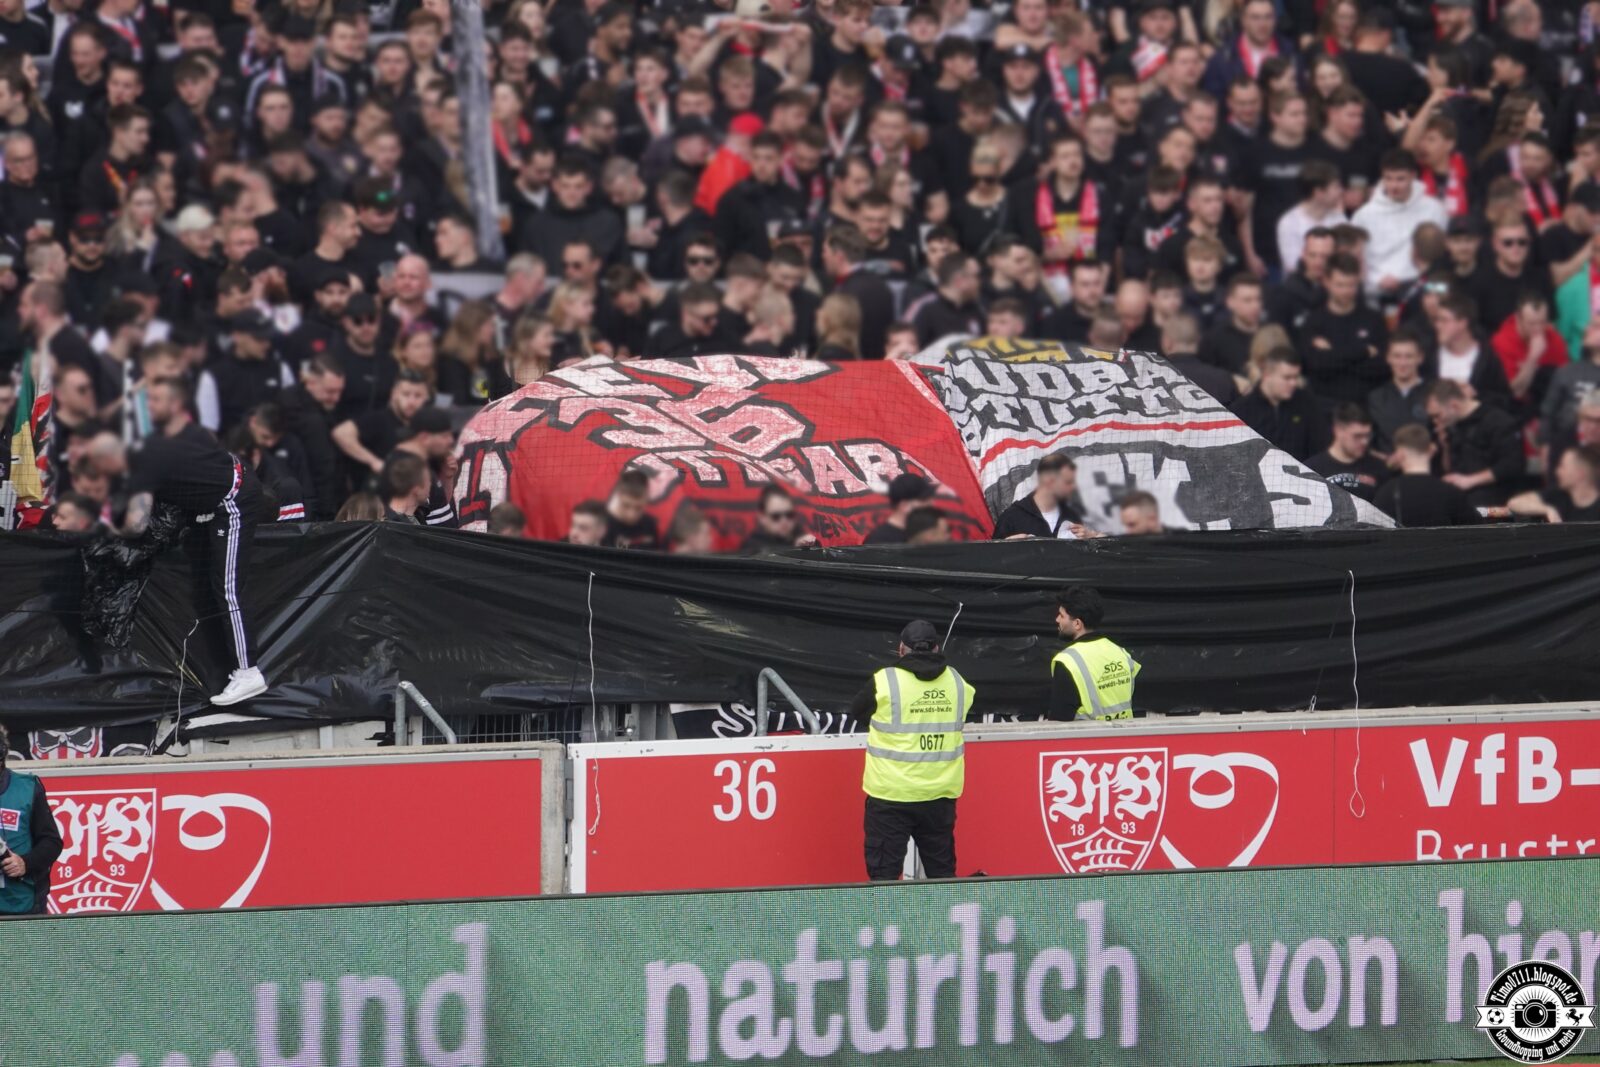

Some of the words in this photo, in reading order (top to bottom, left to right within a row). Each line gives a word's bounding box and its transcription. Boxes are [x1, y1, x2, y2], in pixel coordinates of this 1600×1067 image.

[558, 383, 807, 458] 36
[1104, 661, 1124, 674] SDS
[922, 689, 946, 700] SDS
[909, 705, 953, 714] www.sds-bw.de
[919, 734, 945, 751] 0677
[712, 758, 777, 822] 36
[1045, 754, 1163, 825] VfB
[1070, 823, 1085, 836] 18
[1121, 821, 1136, 834] 93
[57, 865, 73, 879] 18
[109, 863, 126, 877] 93
[255, 922, 487, 1067] und
[643, 899, 1139, 1065] natürlich
[1233, 935, 1399, 1032] von
